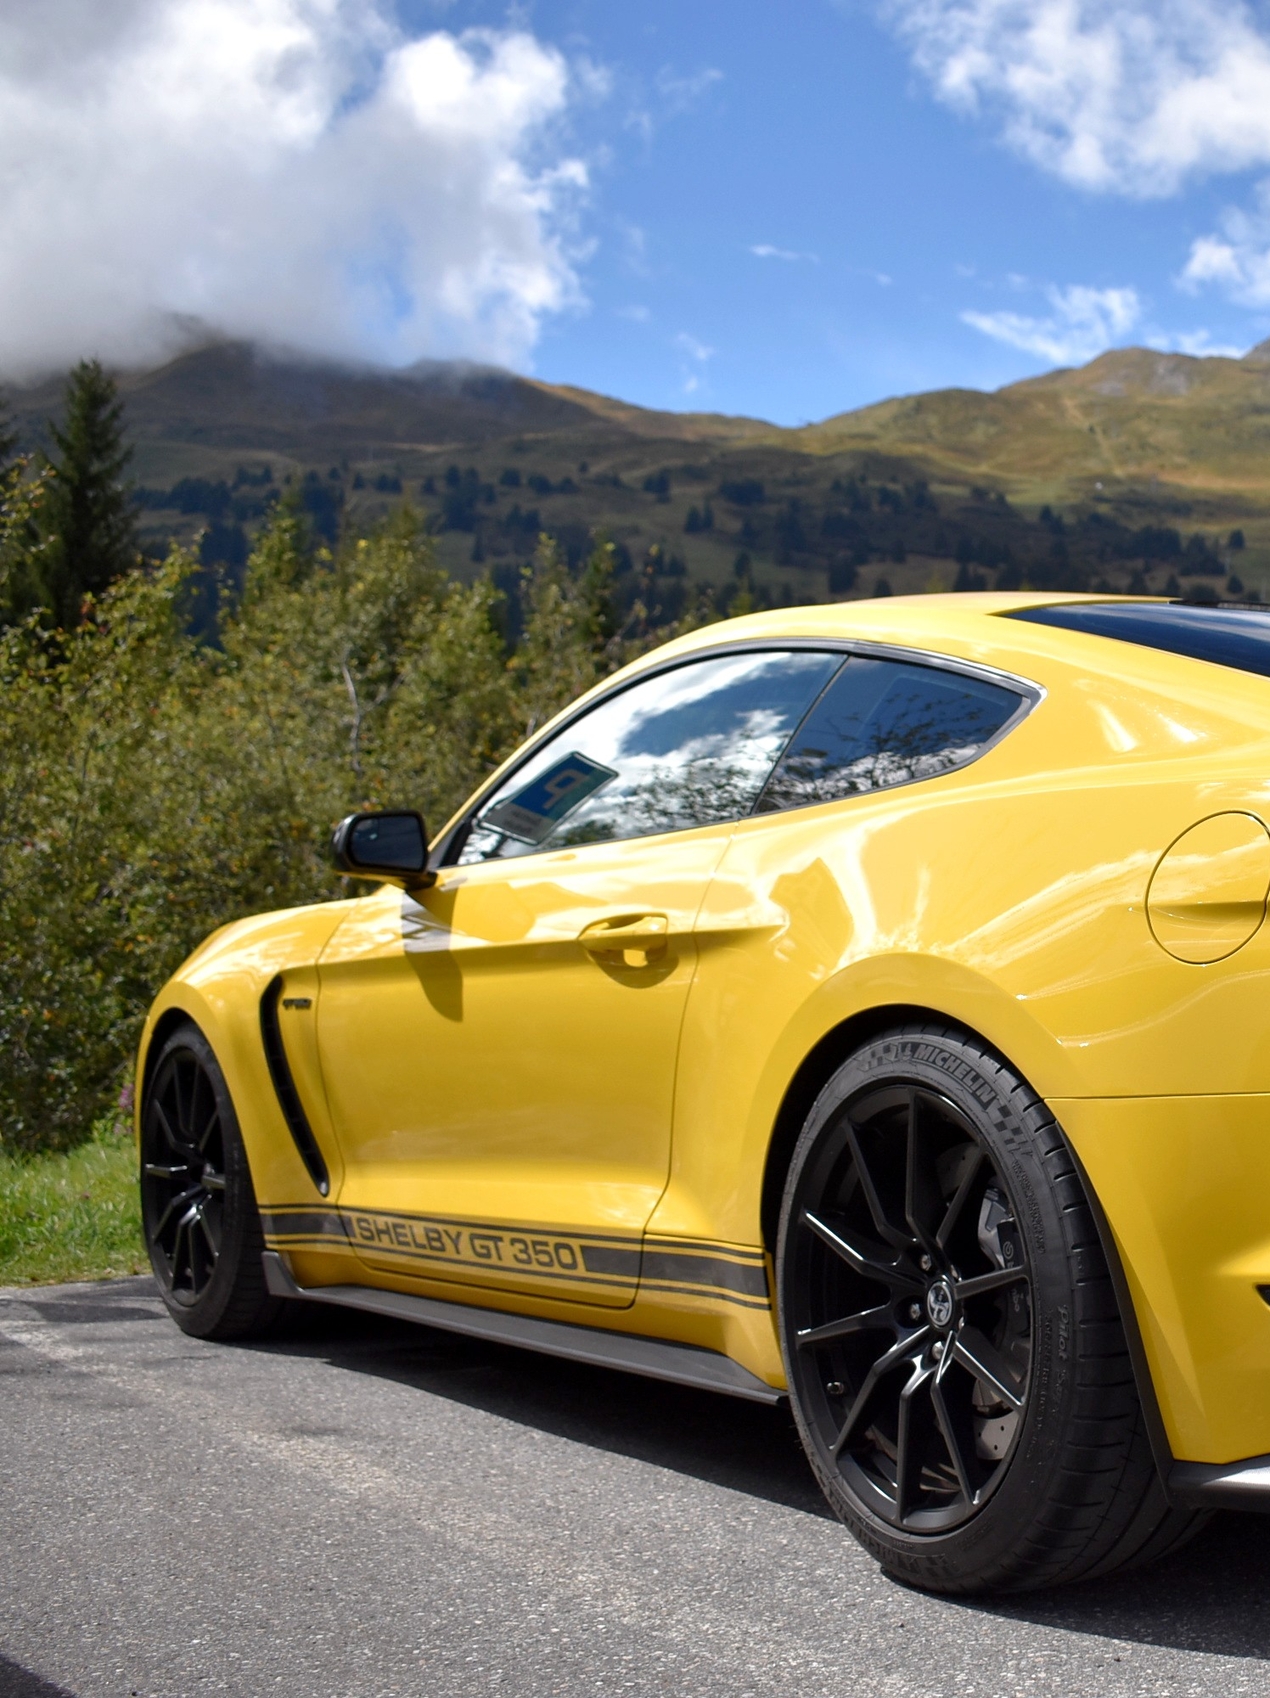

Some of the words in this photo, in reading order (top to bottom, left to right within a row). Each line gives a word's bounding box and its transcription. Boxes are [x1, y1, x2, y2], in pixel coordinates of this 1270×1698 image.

[913, 1044, 998, 1105] MICHELIN
[356, 1217, 463, 1255] SHELBY
[469, 1233, 504, 1262] GT
[510, 1237, 579, 1271] 350
[1057, 1304, 1070, 1361] Pilot
